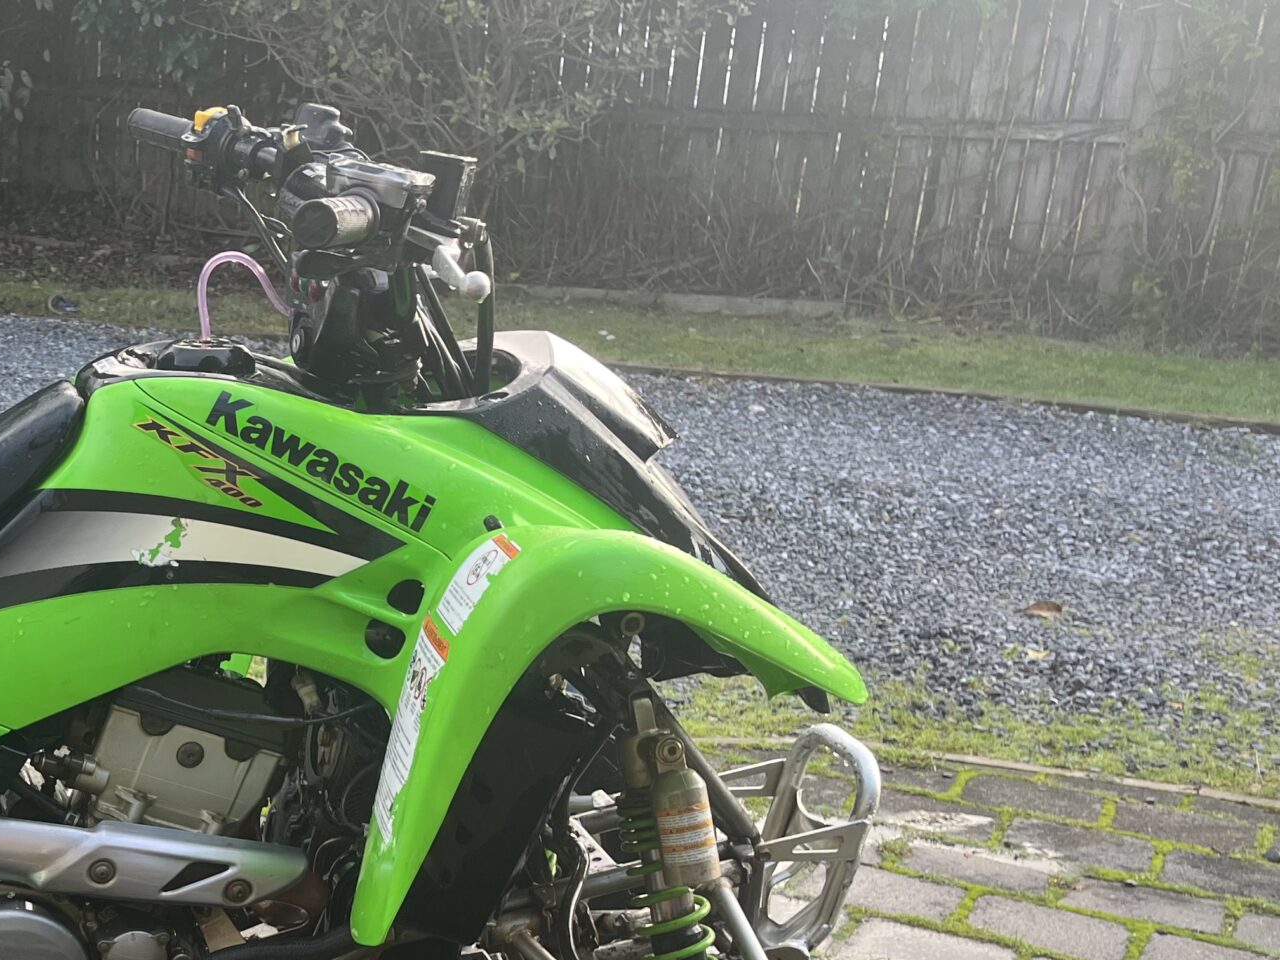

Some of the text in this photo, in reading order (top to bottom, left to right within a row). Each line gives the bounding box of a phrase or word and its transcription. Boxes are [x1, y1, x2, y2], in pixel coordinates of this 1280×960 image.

[132, 415, 261, 488] KFX
[205, 391, 437, 534] Kawasaki
[203, 477, 263, 508] 400
